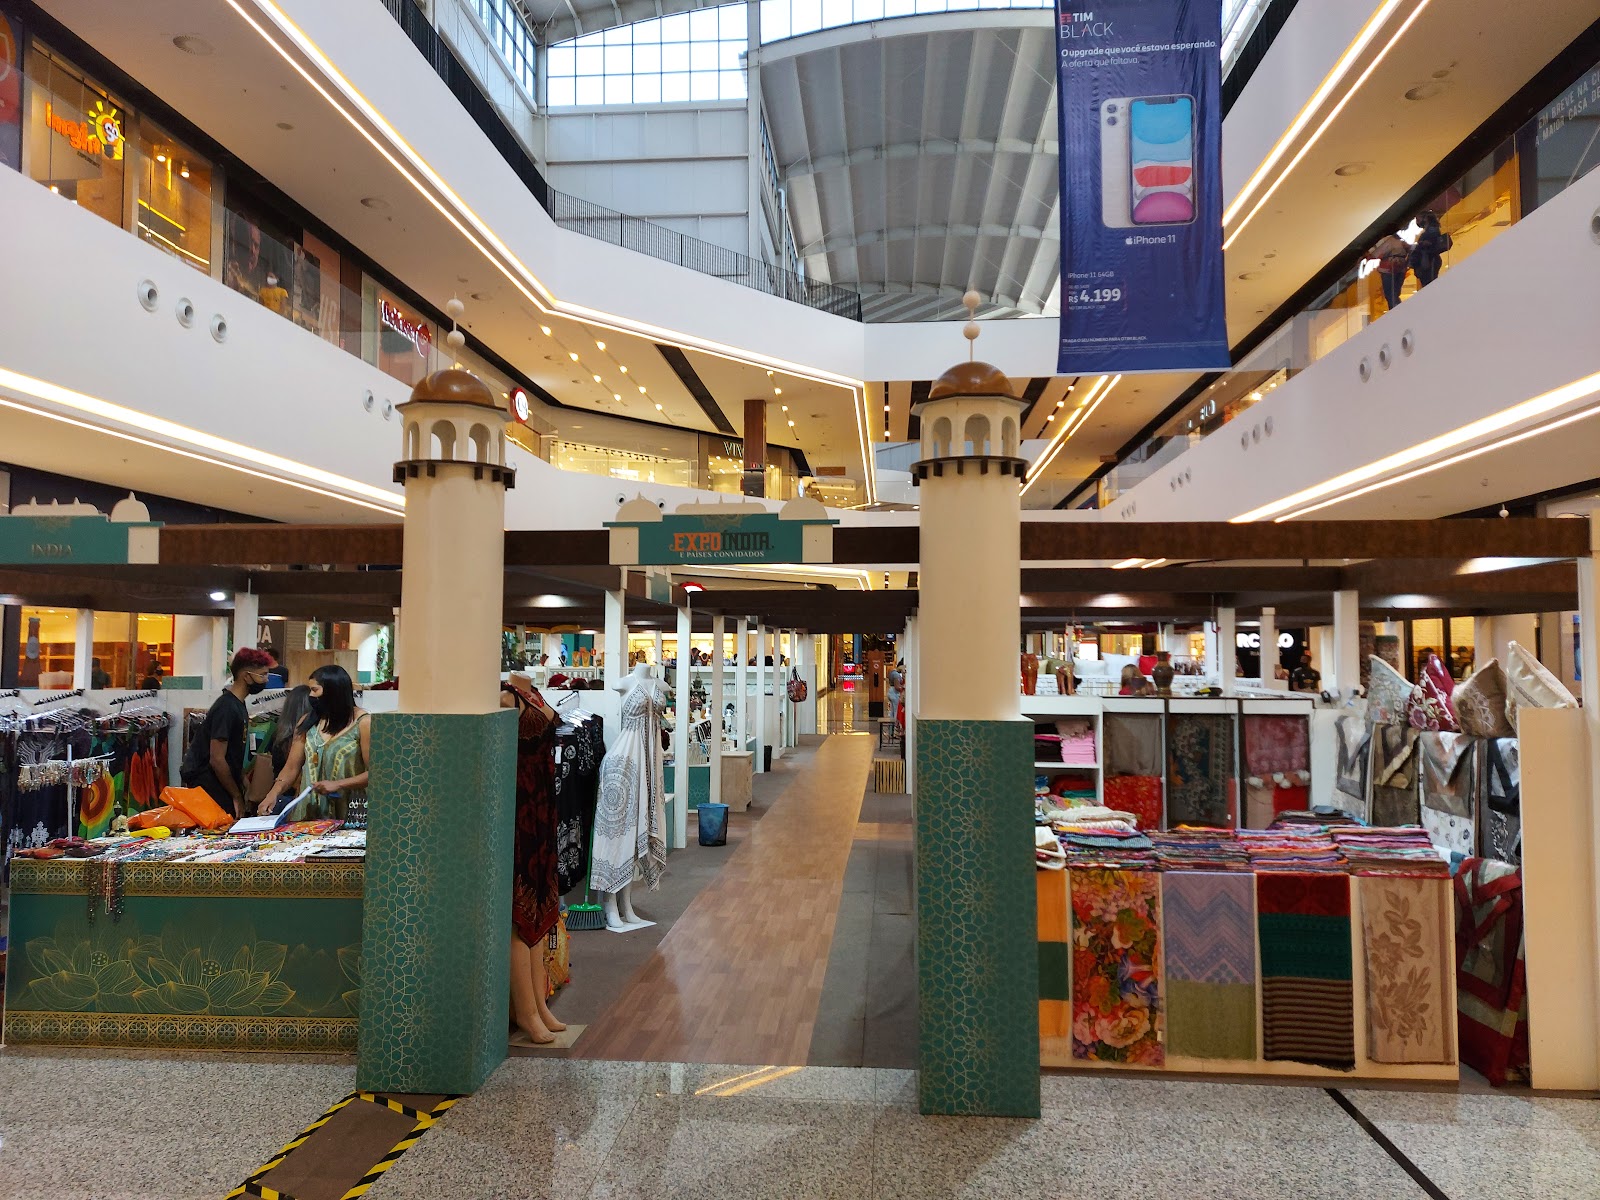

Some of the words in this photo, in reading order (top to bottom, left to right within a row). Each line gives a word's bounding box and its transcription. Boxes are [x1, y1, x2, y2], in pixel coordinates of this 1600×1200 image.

[1072, 12, 1093, 22] TIM
[1060, 22, 1114, 39] BLACK
[1061, 49, 1069, 57] O
[1069, 47, 1104, 58] upgrade
[1104, 47, 1120, 56] que
[1121, 44, 1140, 53] você
[1141, 43, 1170, 52] estava
[1170, 40, 1217, 50] esperando.
[1061, 60, 1068, 68] A
[1068, 59, 1093, 68] oferta
[1094, 59, 1109, 67] que
[1110, 57, 1139, 66] faltava.
[1551, 91, 1574, 119] BREVE
[1577, 80, 1589, 98] NA
[1568, 97, 1588, 121] CASA
[1133, 235, 1167, 245] iPhone
[1167, 234, 1176, 243] 11
[1068, 295, 1079, 303] R$
[1080, 288, 1121, 303] 4.199
[713, 550, 765, 558] CONVIDADOS
